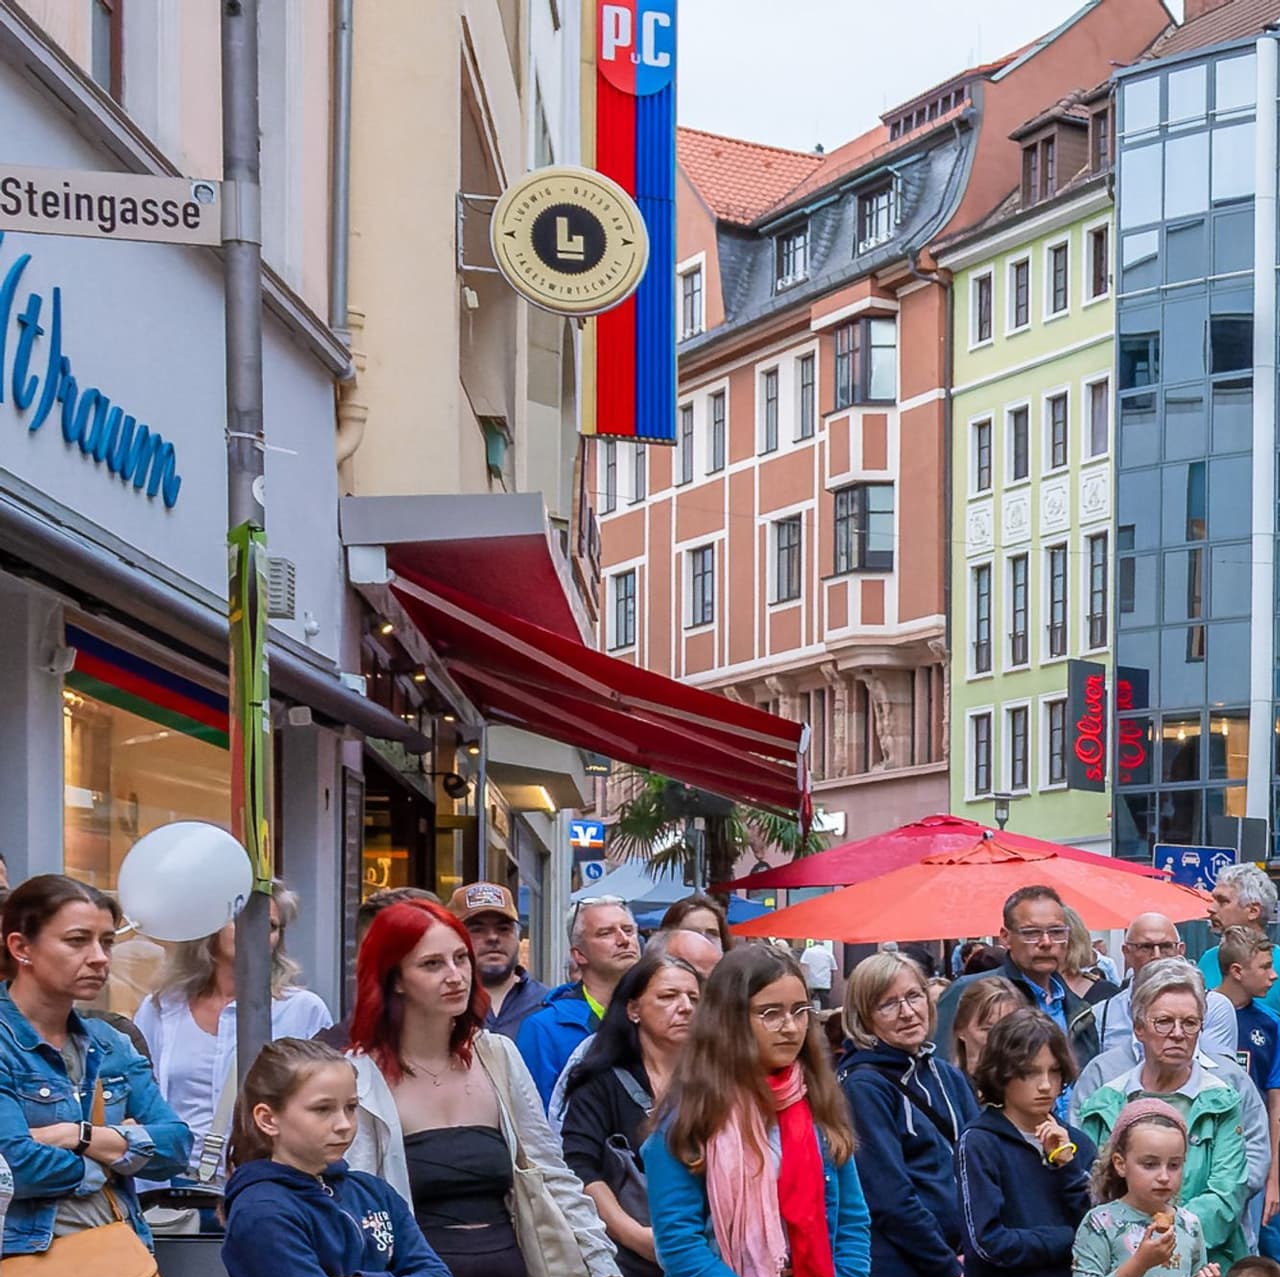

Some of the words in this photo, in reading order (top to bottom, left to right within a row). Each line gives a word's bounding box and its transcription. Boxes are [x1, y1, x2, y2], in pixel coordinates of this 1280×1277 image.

[1, 176, 200, 233] Steingasse
[514, 187, 552, 222] LUDWIG
[516, 252, 623, 295] TAGESWIRTSCHAFT
[1075, 674, 1104, 783] s.Oliver
